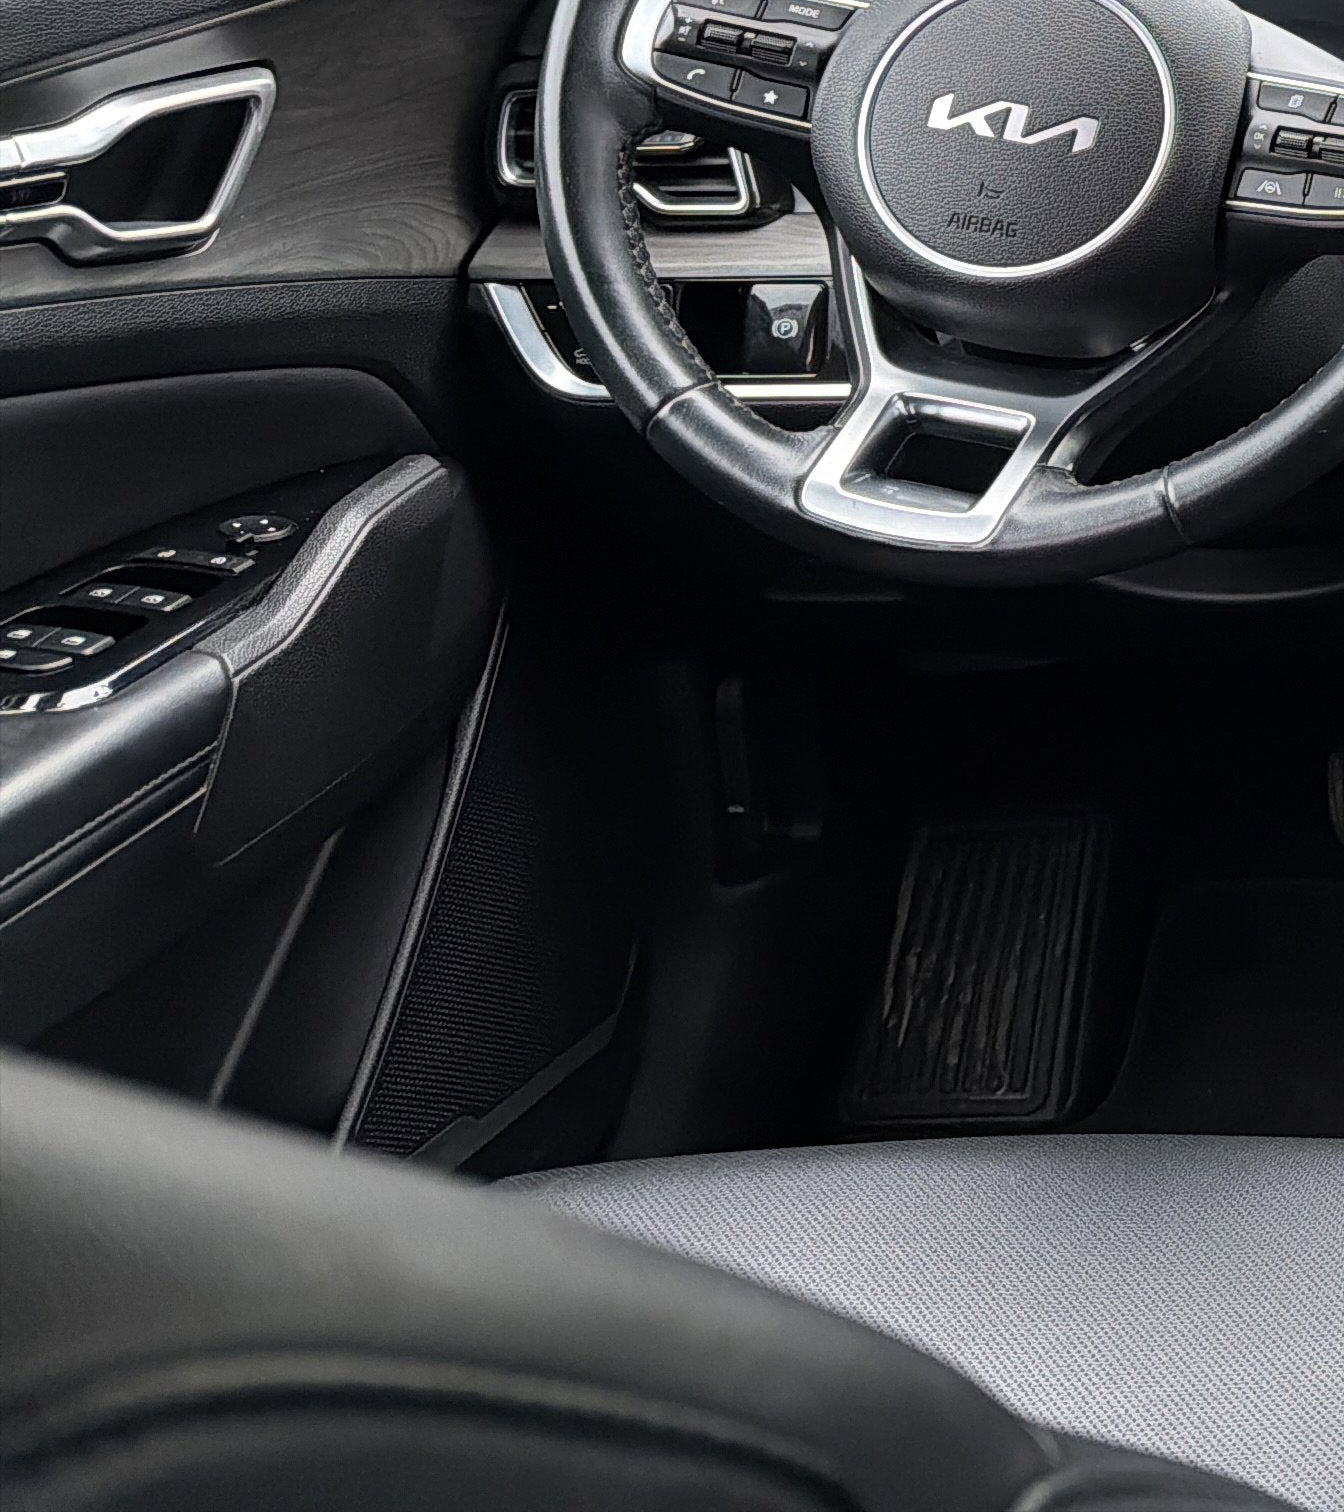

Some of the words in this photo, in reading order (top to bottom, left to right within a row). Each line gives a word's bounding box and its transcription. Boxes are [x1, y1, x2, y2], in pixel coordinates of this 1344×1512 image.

[788, 4, 820, 19] MODE
[927, 93, 1099, 154] KIA
[1253, 131, 1265, 141] OK
[947, 211, 1018, 238] AIRBAG
